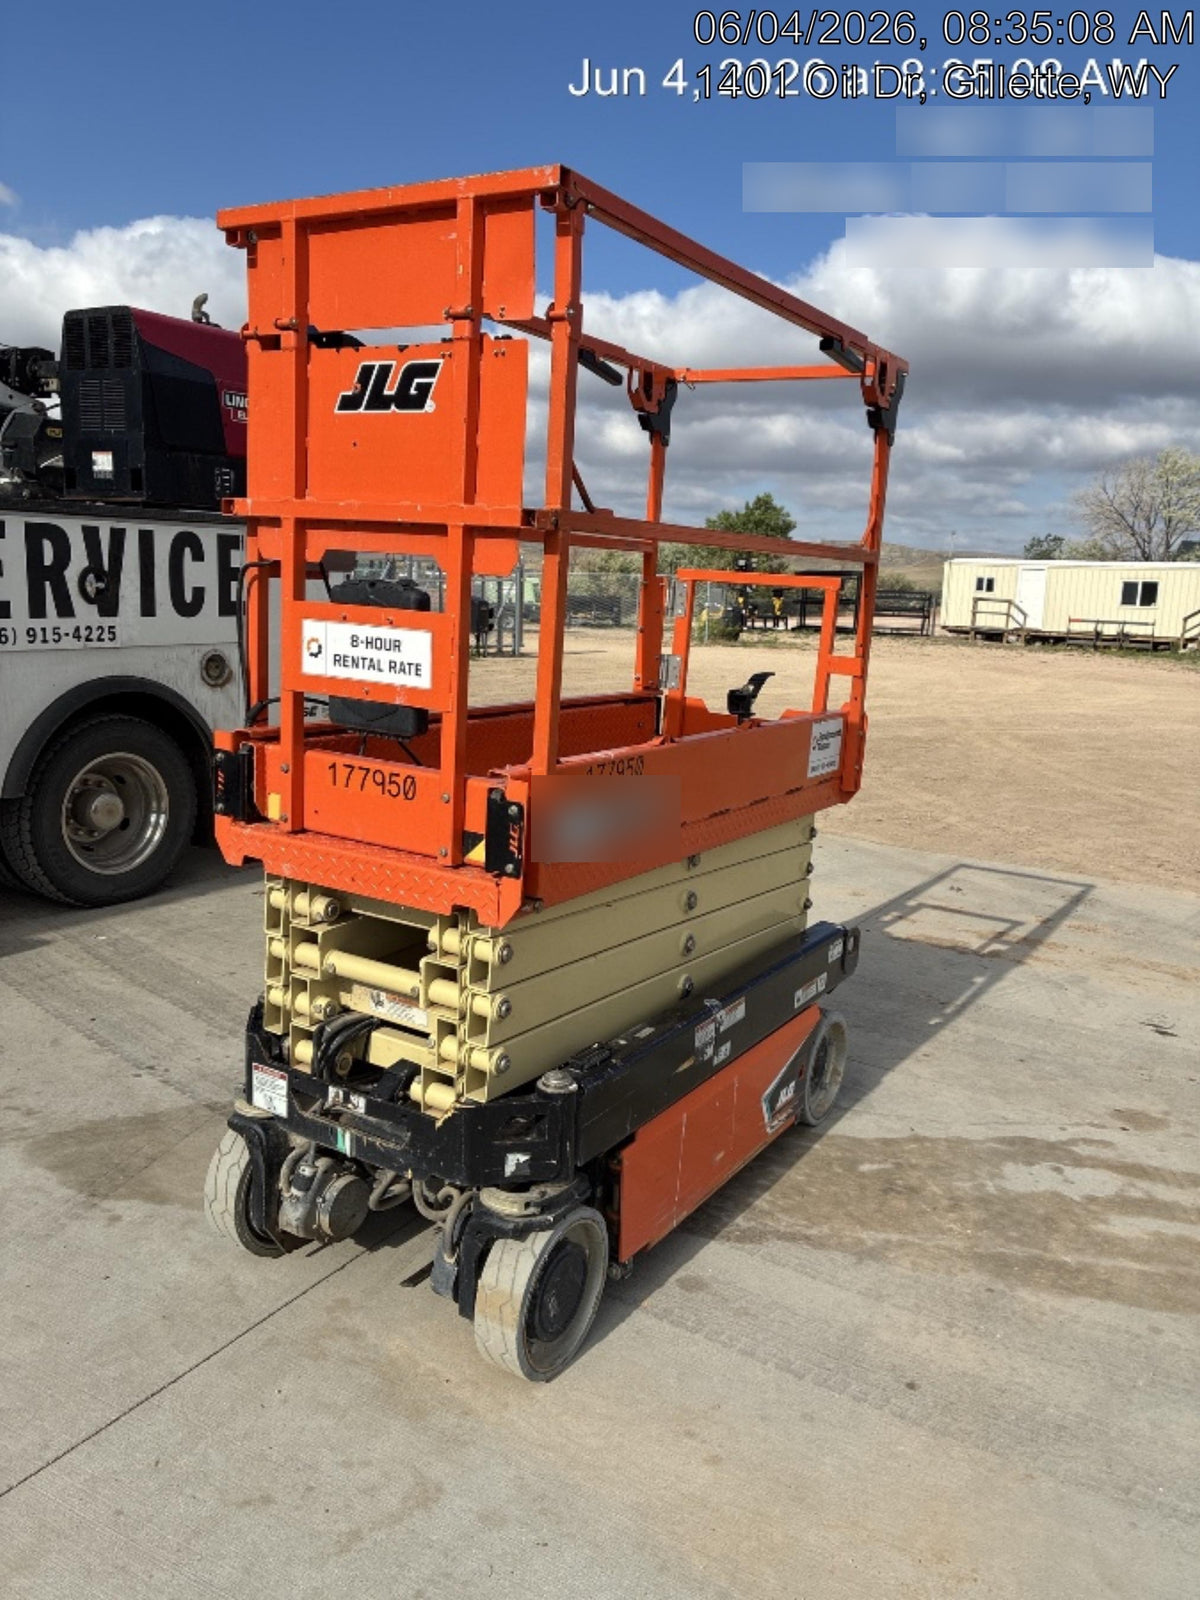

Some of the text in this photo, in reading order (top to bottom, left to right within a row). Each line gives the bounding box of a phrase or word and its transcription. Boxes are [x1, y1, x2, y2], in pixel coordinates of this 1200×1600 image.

[334, 359, 444, 413] JLG
[0, 520, 243, 619] RVICE
[26, 625, 117, 645] 915-4225
[350, 634, 402, 653] 8-HOUR
[333, 654, 422, 677] RENTAL RATE
[328, 762, 417, 801] 177950
